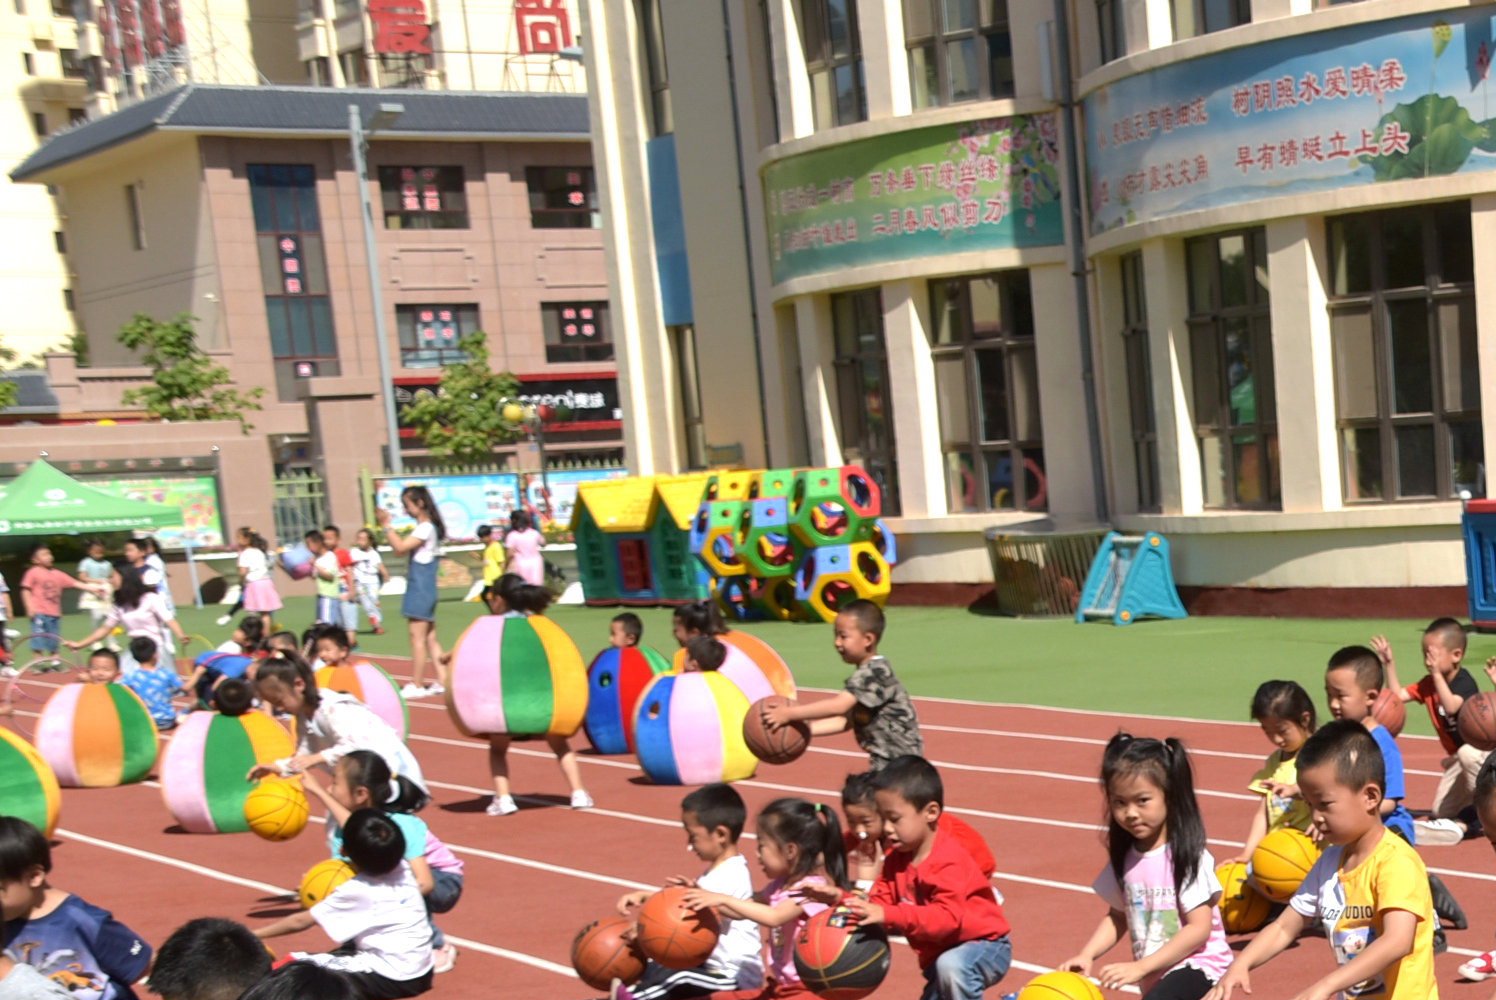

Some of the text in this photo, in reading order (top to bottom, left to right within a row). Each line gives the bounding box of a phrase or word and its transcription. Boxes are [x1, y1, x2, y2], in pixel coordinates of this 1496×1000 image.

[1234, 122, 1410, 175] 早有蜻蜓立上头
[871, 199, 1004, 236] 二月春风似剪刀
